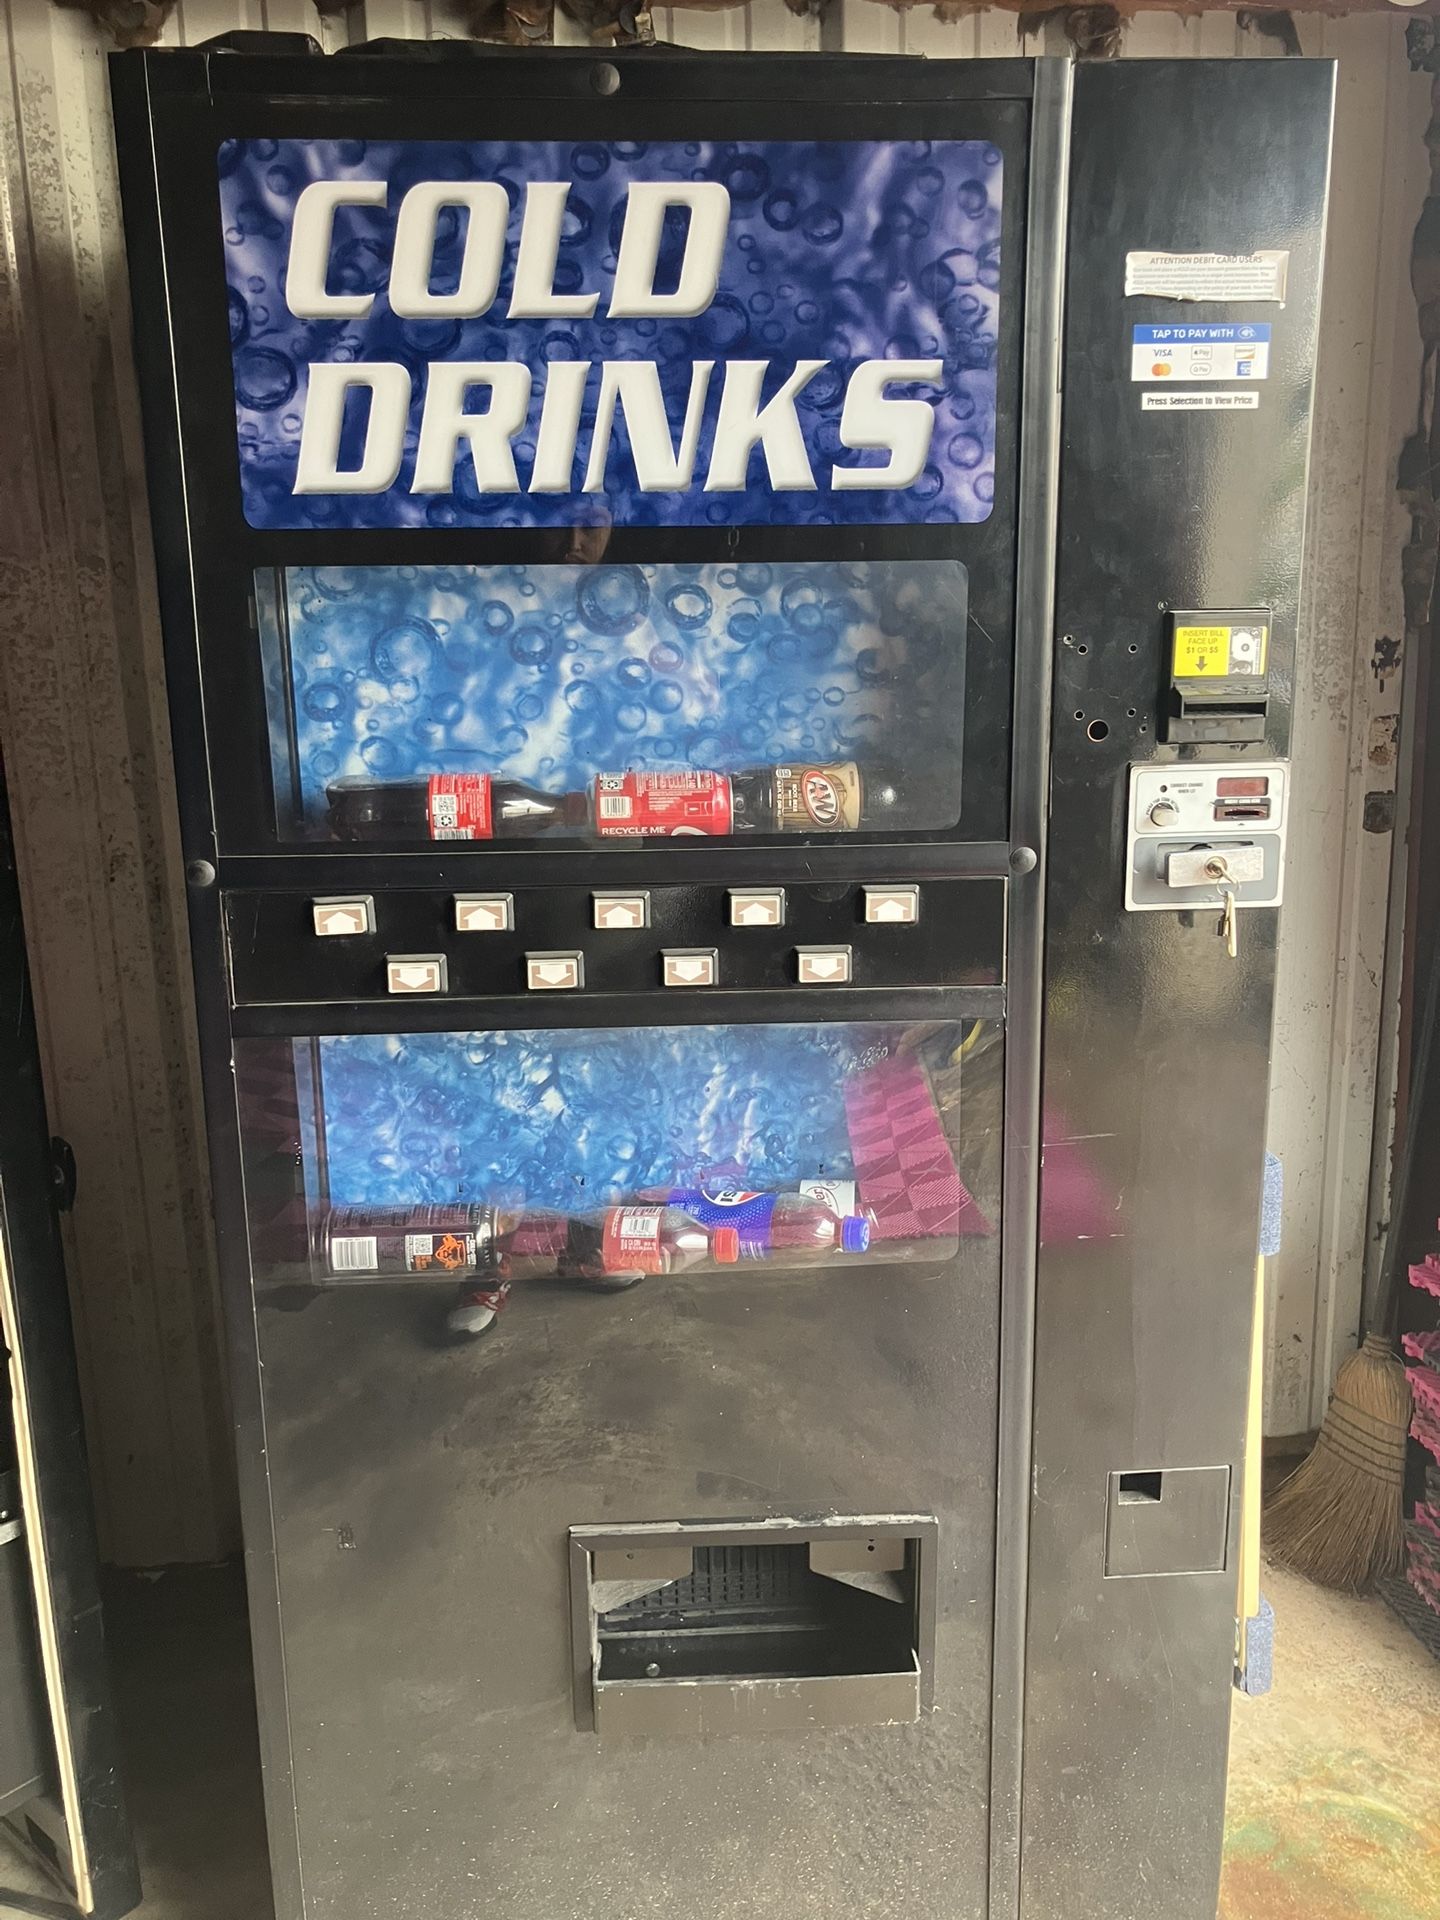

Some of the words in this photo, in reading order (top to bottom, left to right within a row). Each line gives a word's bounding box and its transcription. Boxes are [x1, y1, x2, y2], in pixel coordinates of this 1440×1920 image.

[286, 181, 731, 320] COLD
[1150, 256, 1192, 265] ATTENTION
[1193, 256, 1216, 264] DEBIT
[1216, 255, 1238, 264] CARD
[1239, 255, 1263, 264] USERS
[1152, 329, 1171, 339] TAP
[1173, 329, 1186, 338] TO
[1188, 329, 1207, 338] PAY
[1209, 328, 1234, 338] WITH
[1153, 349, 1173, 357] VISA
[1147, 396, 1167, 406] Press
[1169, 396, 1204, 406] Selection
[1205, 397, 1213, 405] to
[1214, 396, 1232, 405] View
[1234, 396, 1253, 405] Price
[292, 359, 944, 496] DRINKS
[1182, 629, 1208, 637] INSERT
[1209, 629, 1224, 637] BILL
[1186, 646, 1195, 654] $1
[1209, 646, 1219, 654] $5
[601, 826, 648, 835] RECYCLE
[649, 825, 666, 834] ME
